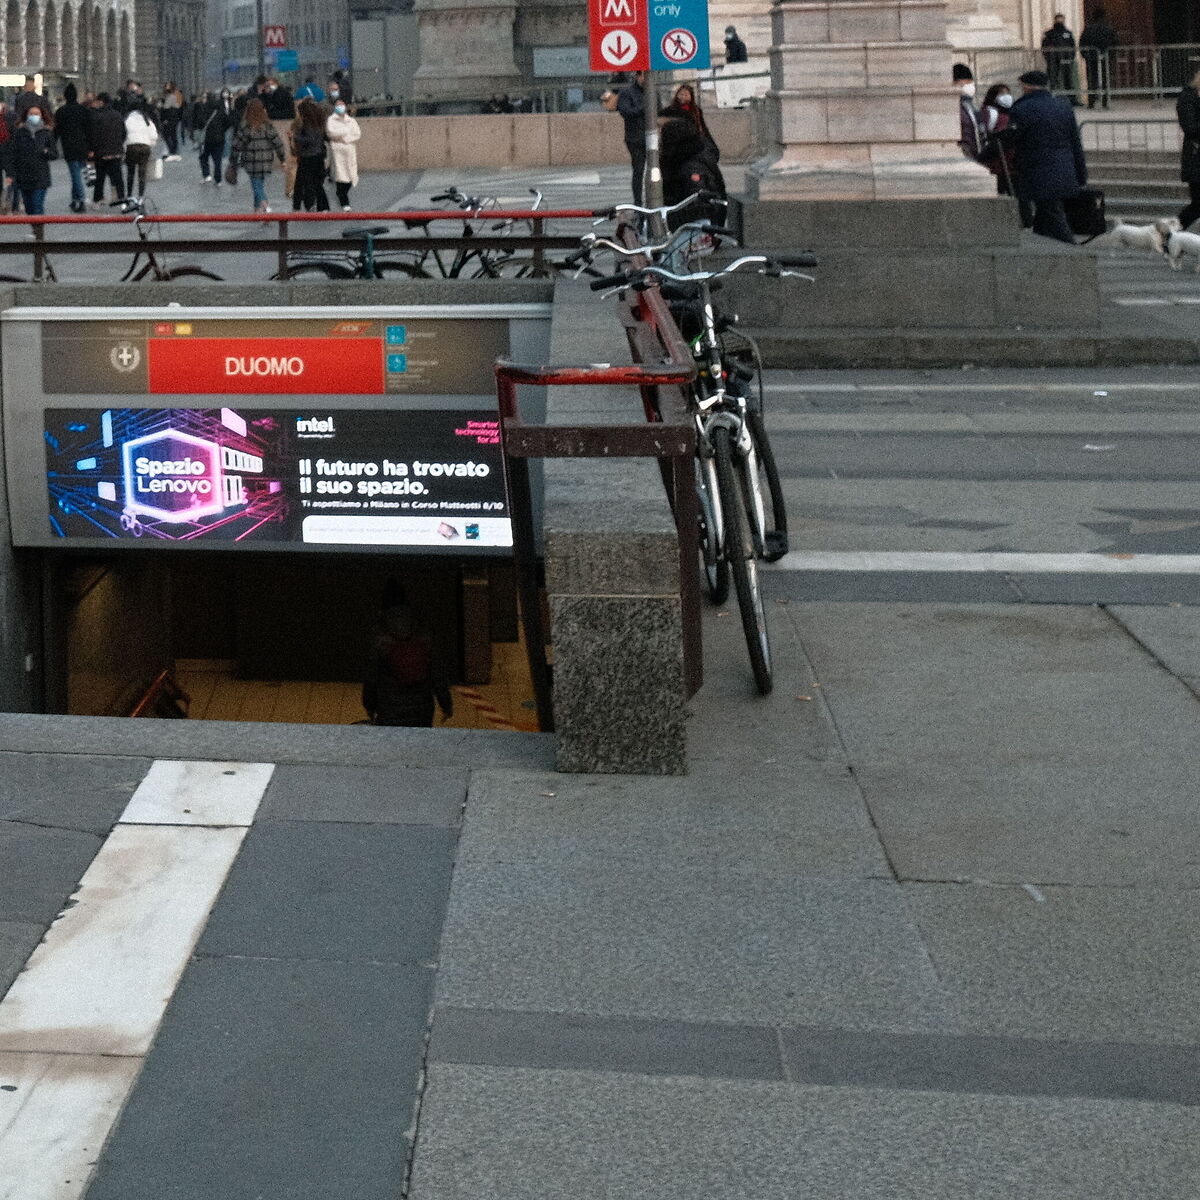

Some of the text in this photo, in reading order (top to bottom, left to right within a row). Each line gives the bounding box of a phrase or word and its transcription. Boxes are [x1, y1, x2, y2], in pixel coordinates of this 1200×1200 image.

[654, 5, 681, 18] only
[225, 356, 304, 376] DUOMO
[135, 457, 205, 477] Spazio
[299, 459, 490, 477] Il futuro ha trovato
[137, 477, 212, 494] Lenovo
[299, 477, 429, 497] il suo spazio.
[301, 500, 311, 508] Ti
[312, 500, 361, 509] aspettiamo
[370, 501, 400, 509] Milano
[411, 501, 438, 509] Corso
